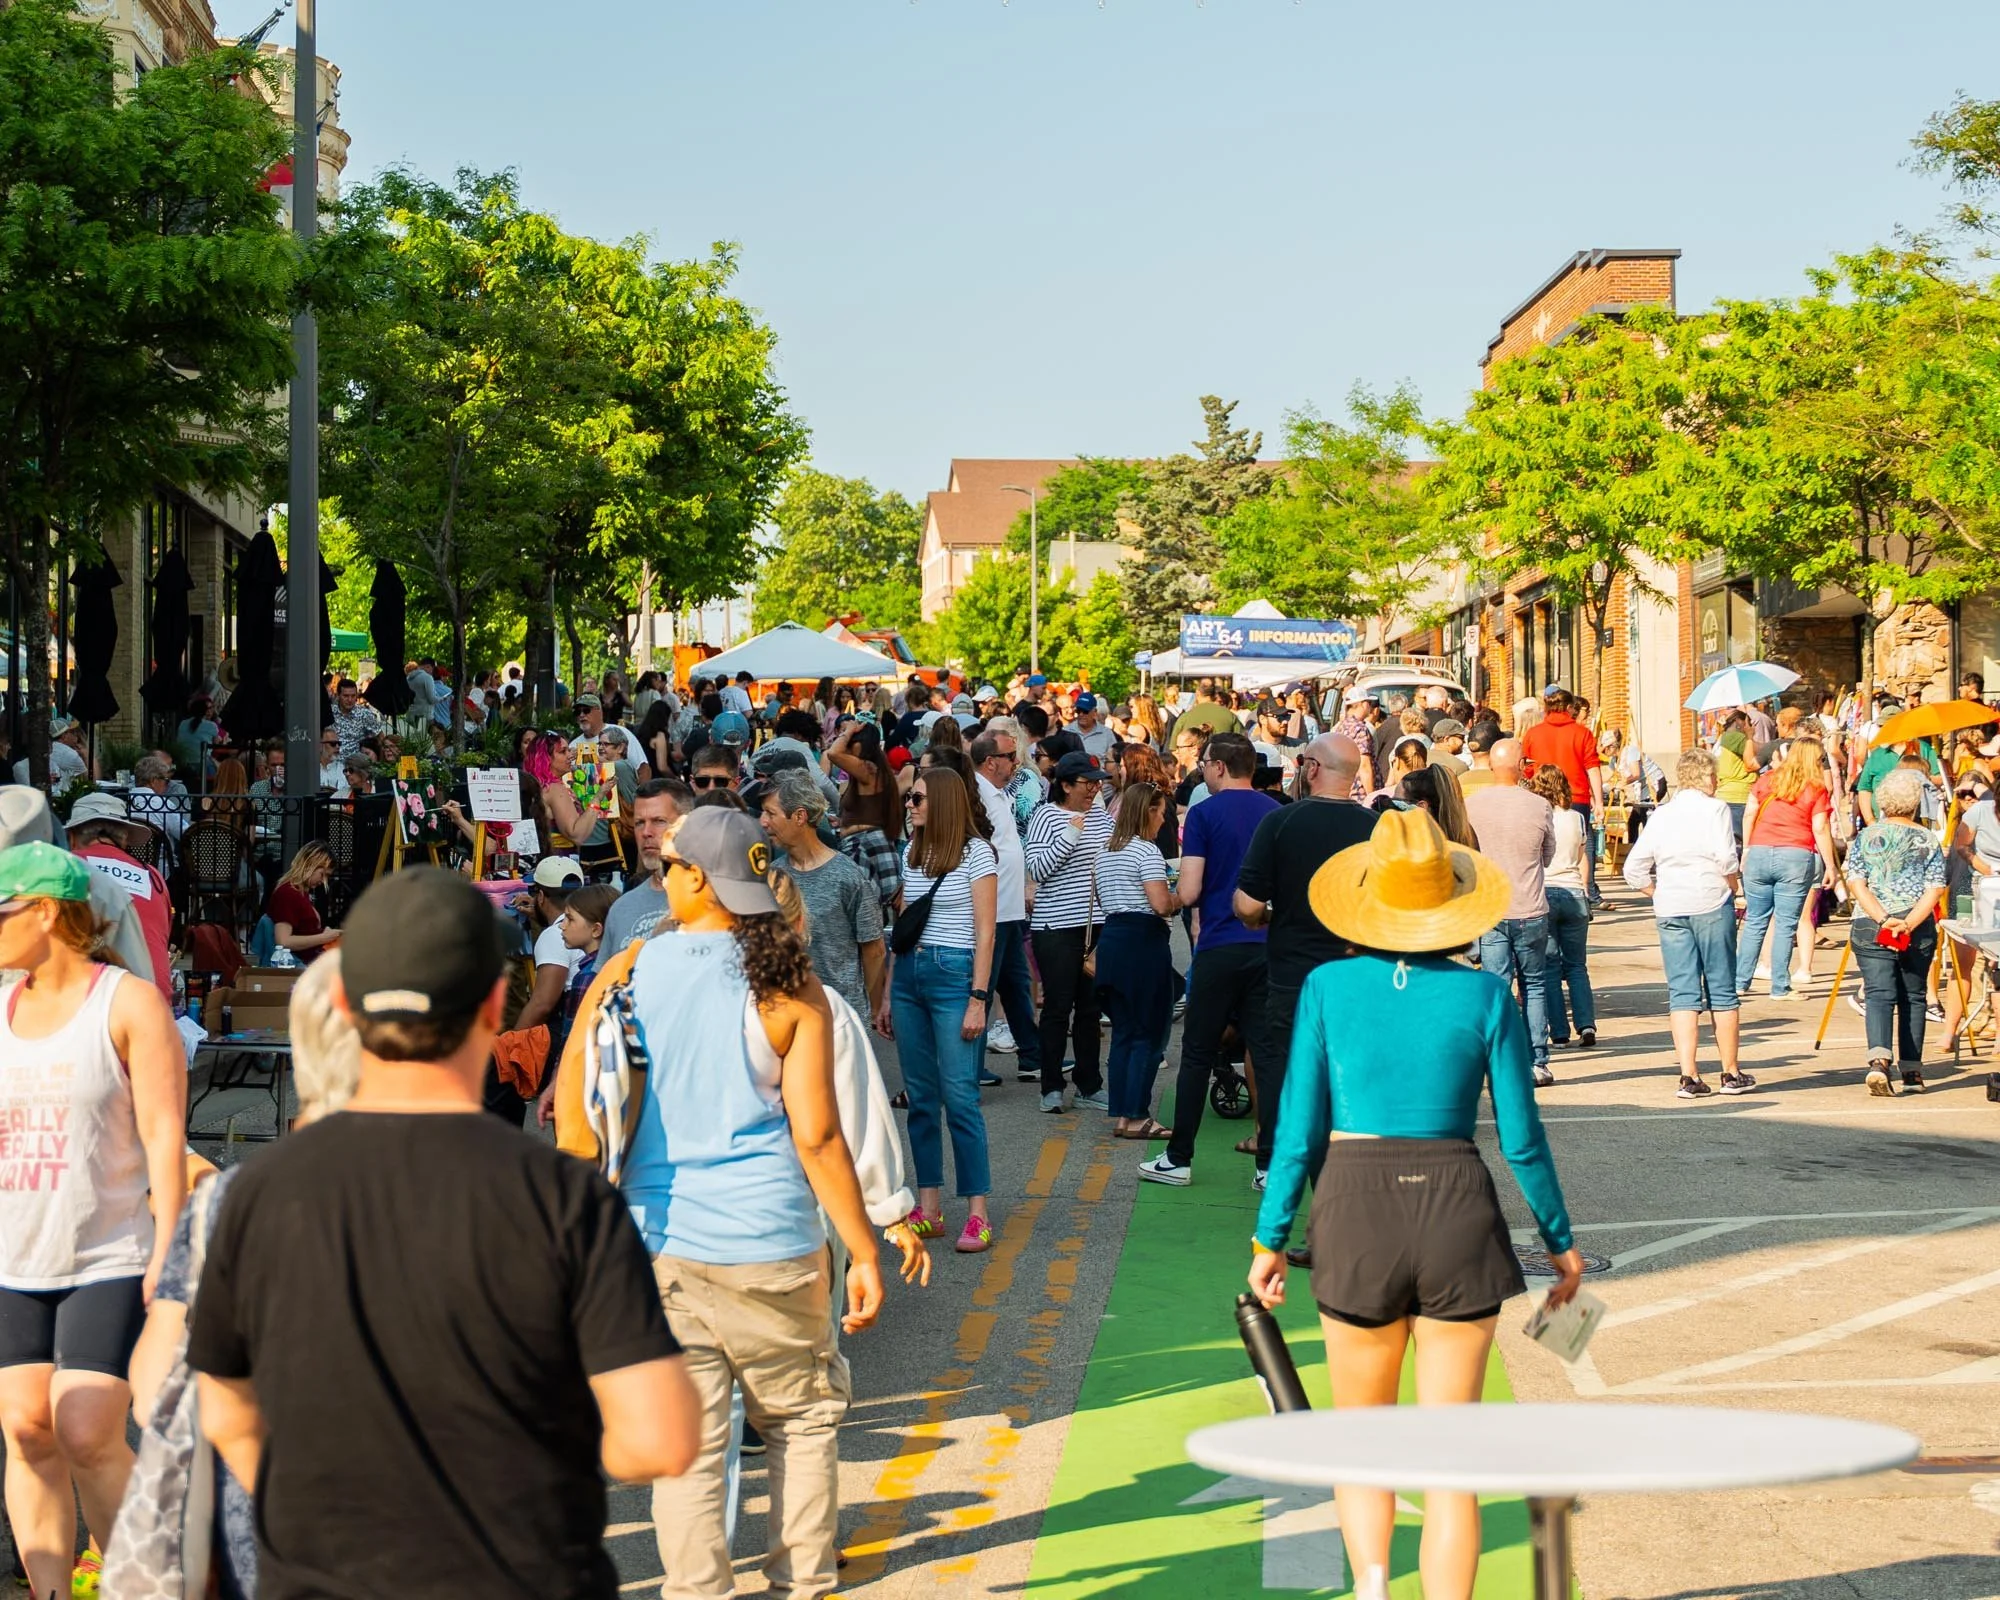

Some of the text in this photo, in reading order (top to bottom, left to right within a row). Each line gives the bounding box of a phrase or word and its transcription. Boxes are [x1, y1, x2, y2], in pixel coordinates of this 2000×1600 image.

[1187, 620, 1226, 636] ART
[1219, 629, 1243, 645] 64
[1249, 631, 1352, 645] INFORMATION
[96, 865, 143, 883] #022
